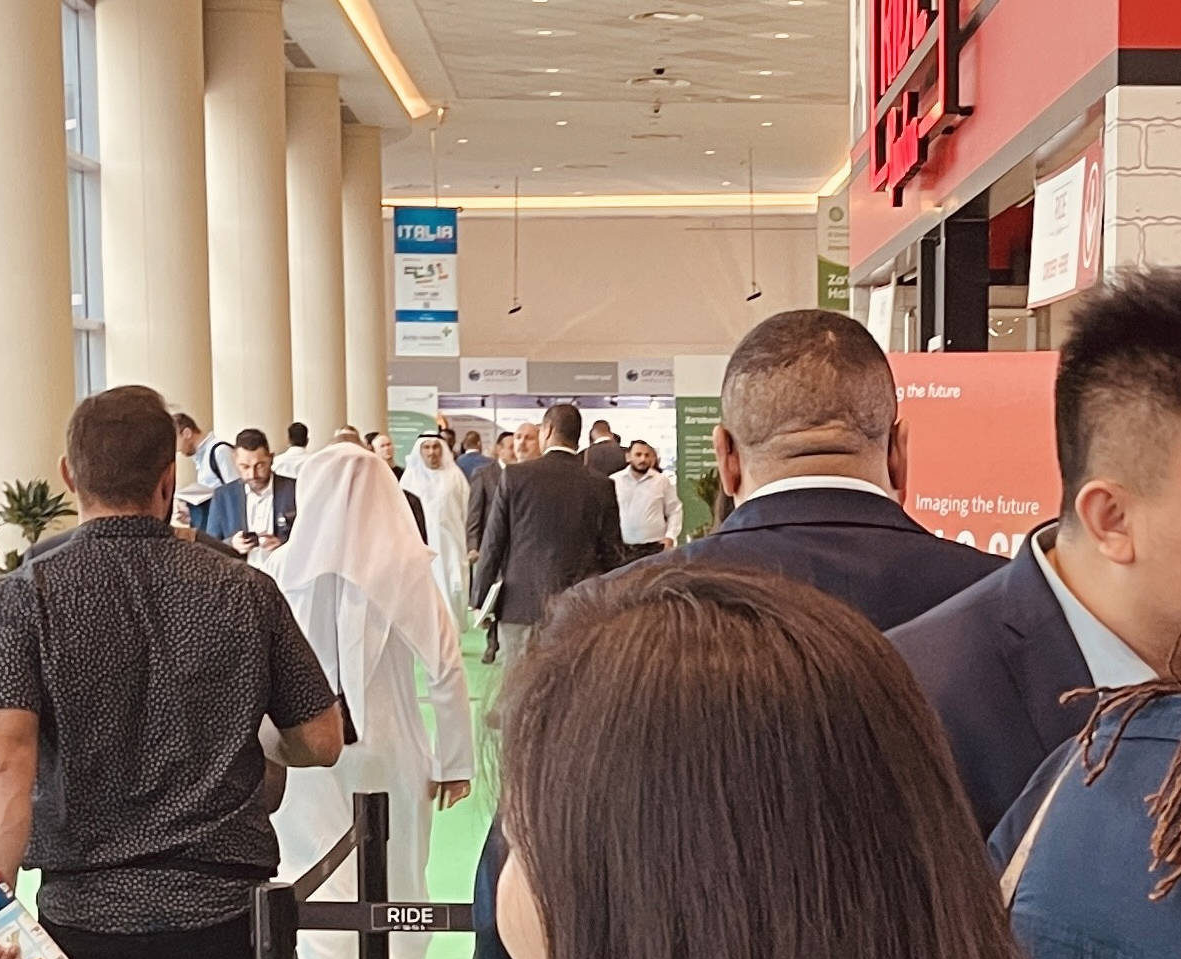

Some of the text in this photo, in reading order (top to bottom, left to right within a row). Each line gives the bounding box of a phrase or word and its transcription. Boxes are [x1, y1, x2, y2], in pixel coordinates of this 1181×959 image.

[397, 224, 454, 242] ITALIA
[907, 383, 926, 399] the
[927, 384, 961, 398] future
[916, 494, 1040, 517] Imaging the future
[387, 907, 434, 923] RIDE
